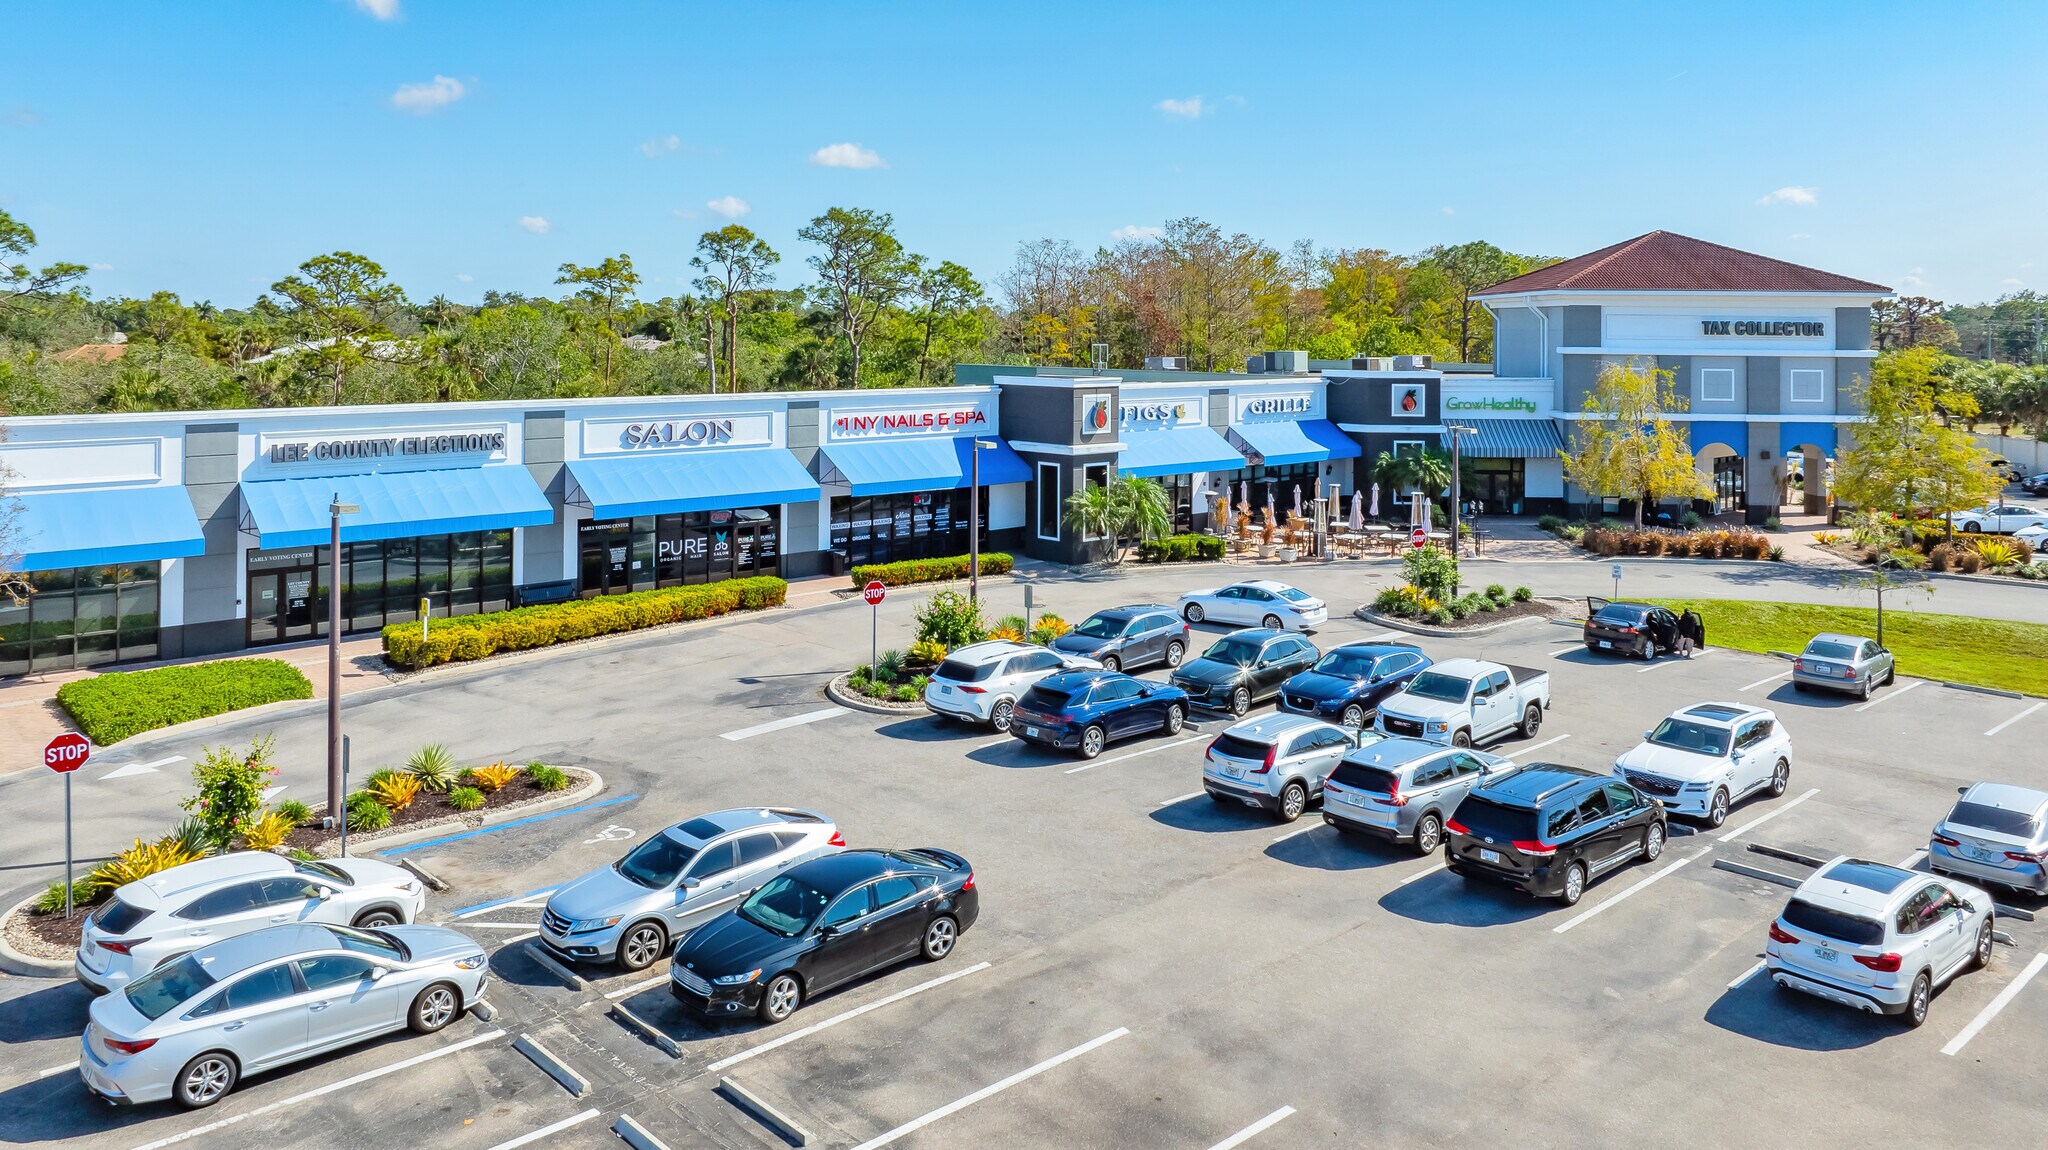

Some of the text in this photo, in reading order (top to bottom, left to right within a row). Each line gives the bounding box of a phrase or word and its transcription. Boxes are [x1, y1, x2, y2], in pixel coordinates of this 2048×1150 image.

[1702, 321, 1824, 336] TAX COLLECTOR
[1123, 403, 1172, 421] FIGS
[1446, 396, 1536, 413] GrowHealthy
[837, 411, 985, 431] #1 NY NAILS & SPA
[626, 419, 737, 445] SALON
[271, 432, 505, 463] LEE COUNTY ELECTIONS
[659, 537, 708, 557] PURE
[1412, 535, 1425, 543] STOP
[865, 588, 885, 599] STOP
[47, 744, 87, 763] STOP
